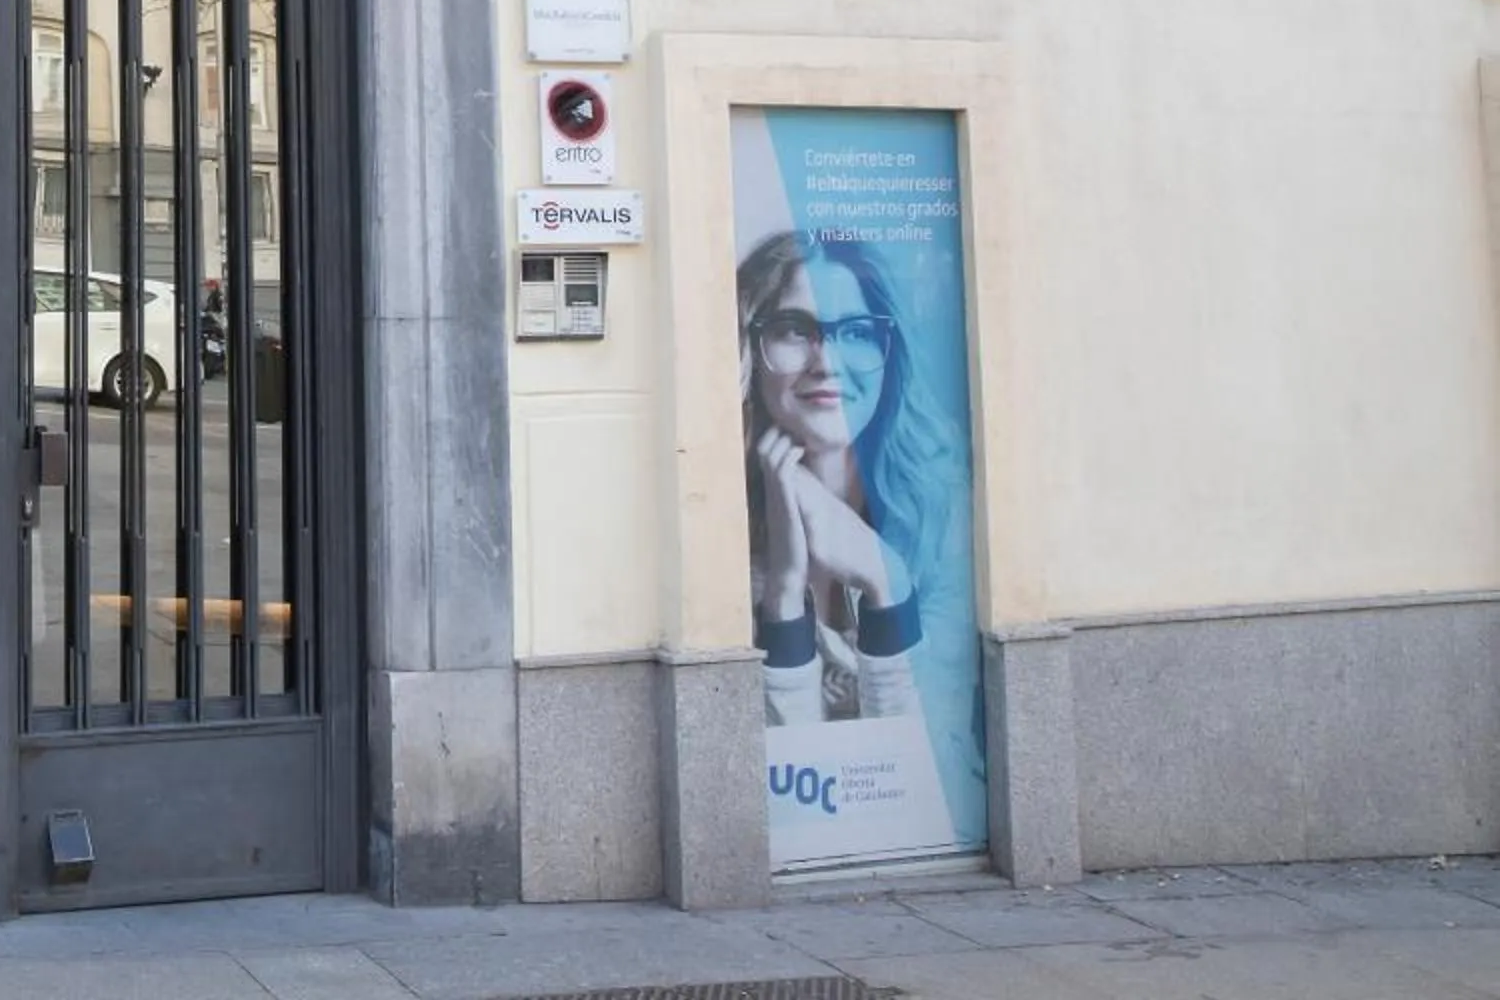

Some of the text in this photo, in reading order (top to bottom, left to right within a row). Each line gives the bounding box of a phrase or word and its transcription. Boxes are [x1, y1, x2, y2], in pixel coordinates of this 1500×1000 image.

[555, 146, 603, 163] entro
[804, 150, 915, 168] Conviértete en
[807, 201, 959, 220] con nuestros grados
[807, 228, 816, 246] y
[887, 223, 933, 242] online
[769, 764, 837, 814] UOC
